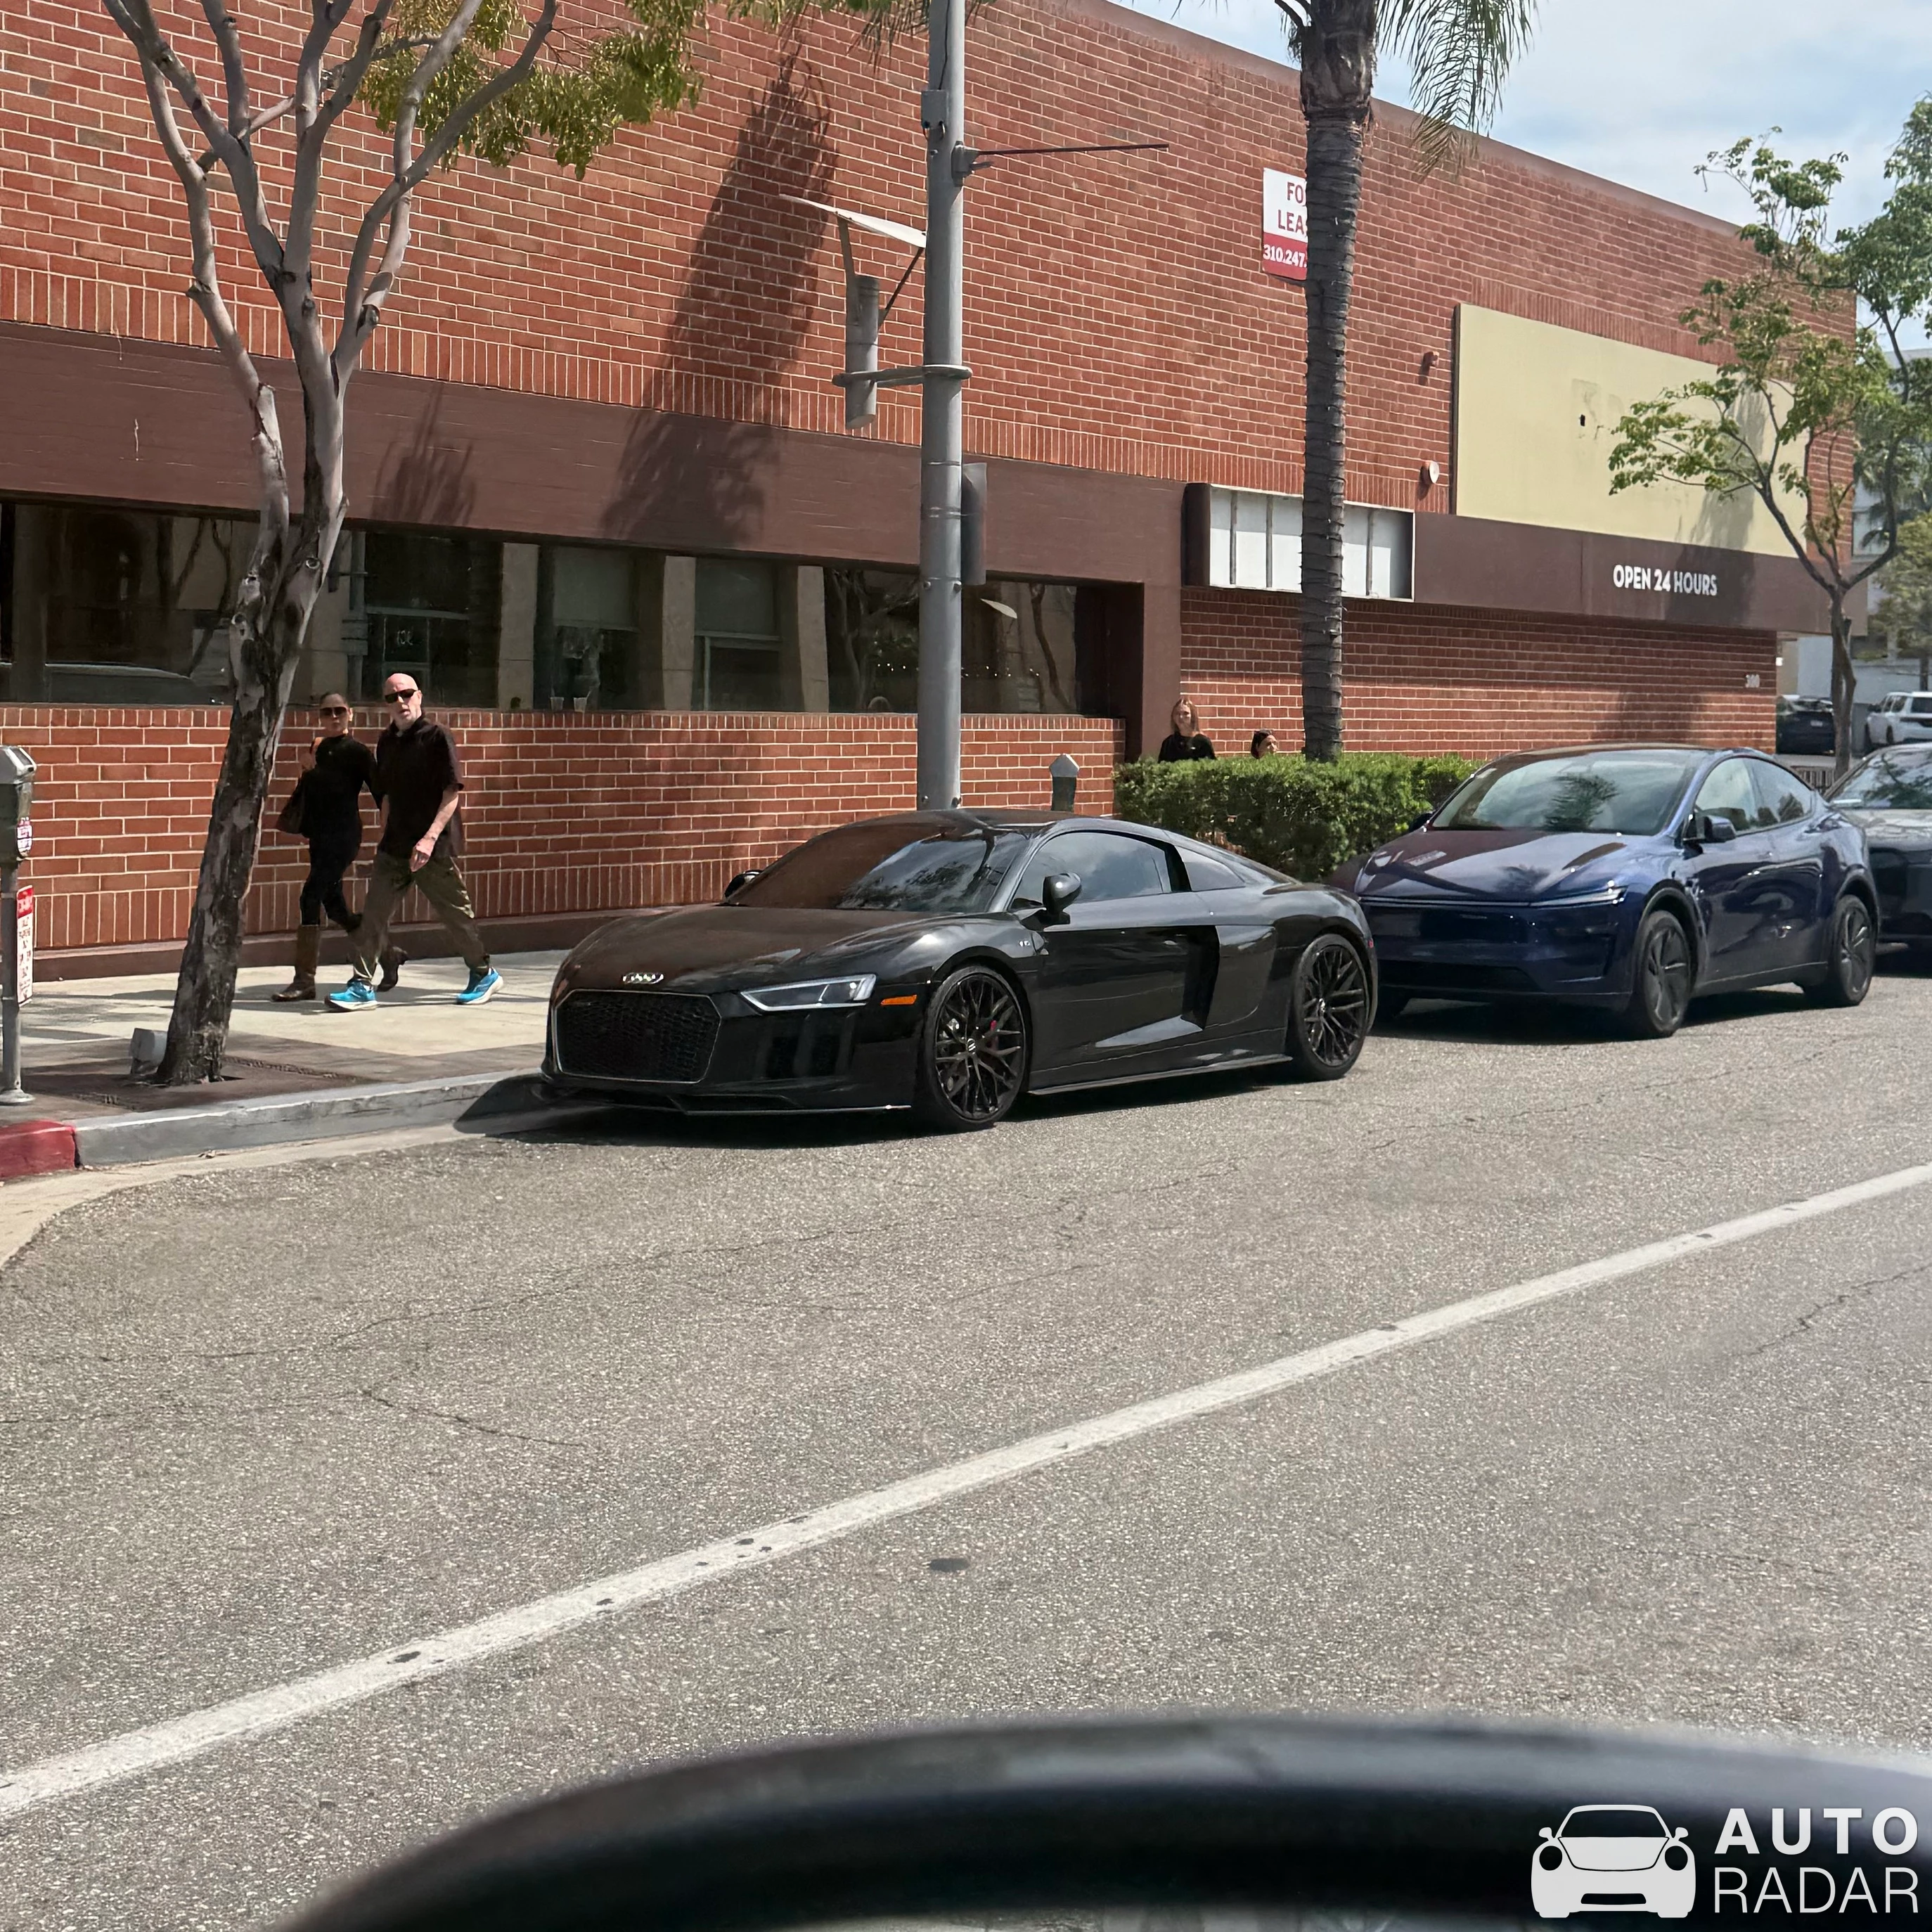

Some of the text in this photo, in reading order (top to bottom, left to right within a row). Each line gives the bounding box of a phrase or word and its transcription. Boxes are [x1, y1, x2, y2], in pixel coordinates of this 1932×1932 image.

[1287, 181, 1304, 204] FO
[1277, 210, 1304, 235] LEA
[1263, 243, 1308, 269] 310.247.
[1613, 565, 1718, 596] OPEN 24 HOURS
